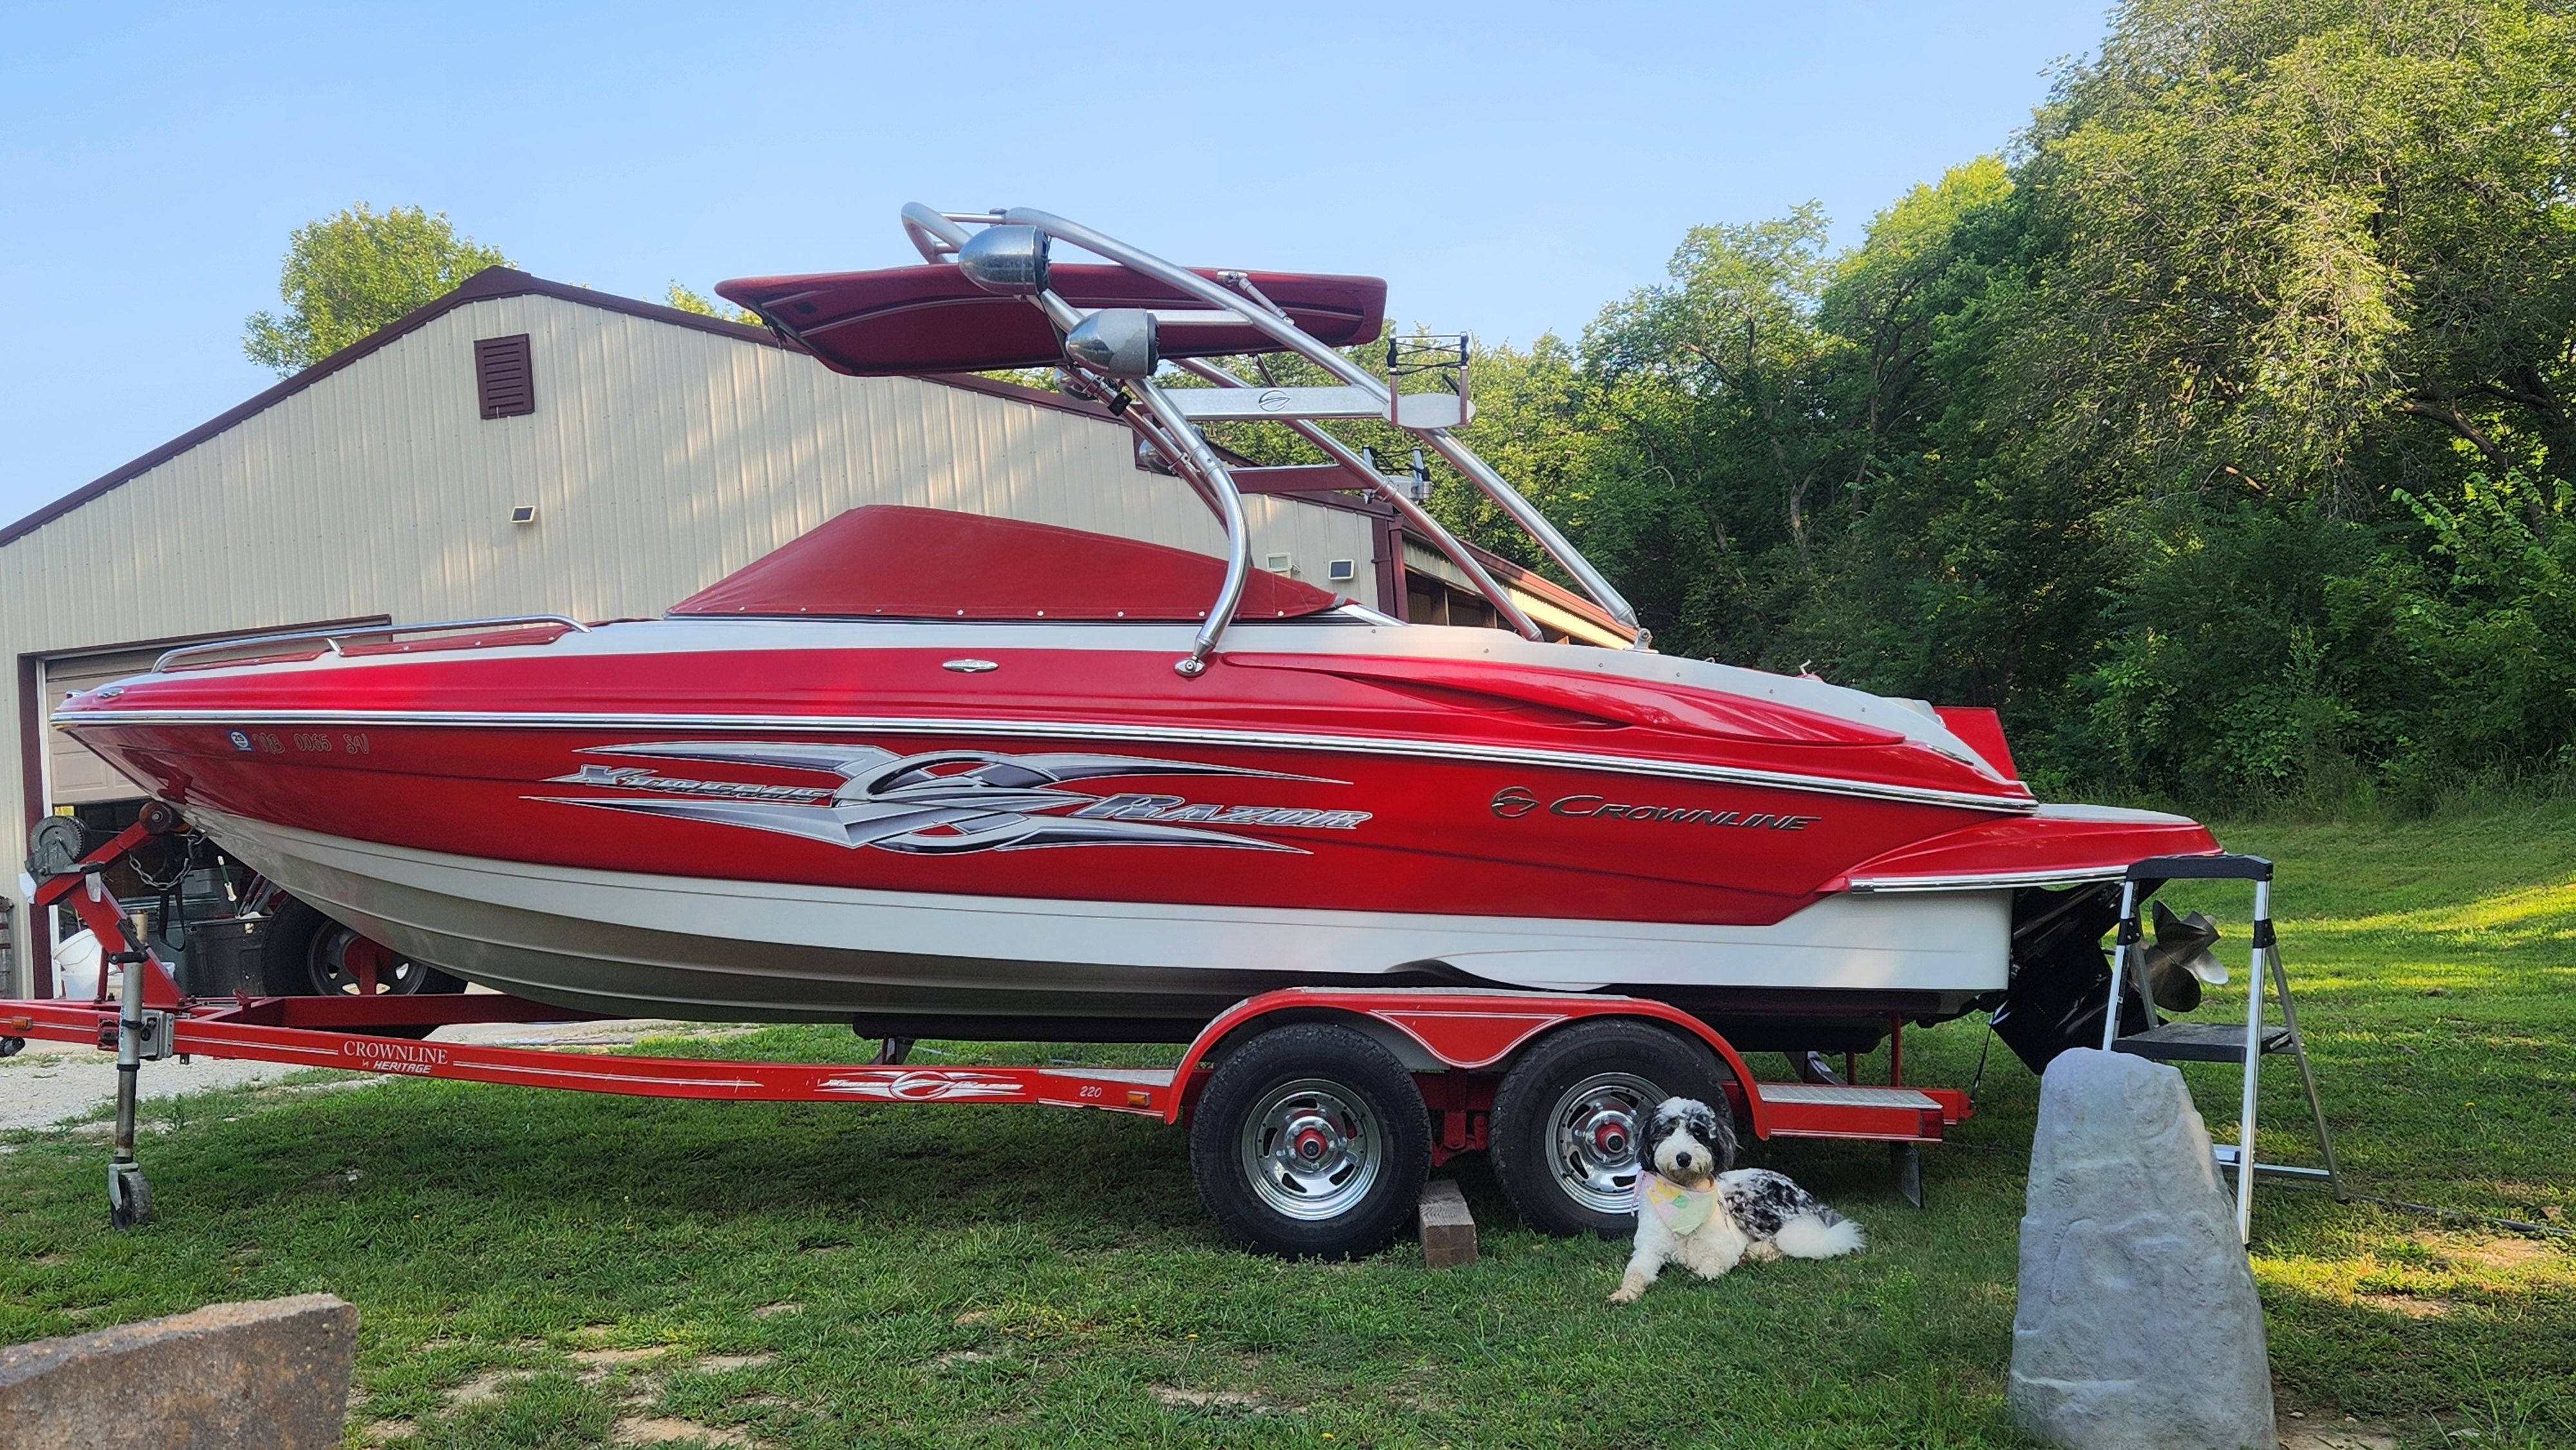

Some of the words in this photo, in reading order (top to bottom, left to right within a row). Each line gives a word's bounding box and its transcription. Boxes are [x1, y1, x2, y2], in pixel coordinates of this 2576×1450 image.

[1549, 795, 1823, 831] CROWNLINE
[343, 1040, 448, 1065] CROWNLINE
[374, 1060, 432, 1074] HERITAGE
[1079, 1086, 1103, 1098] 220
